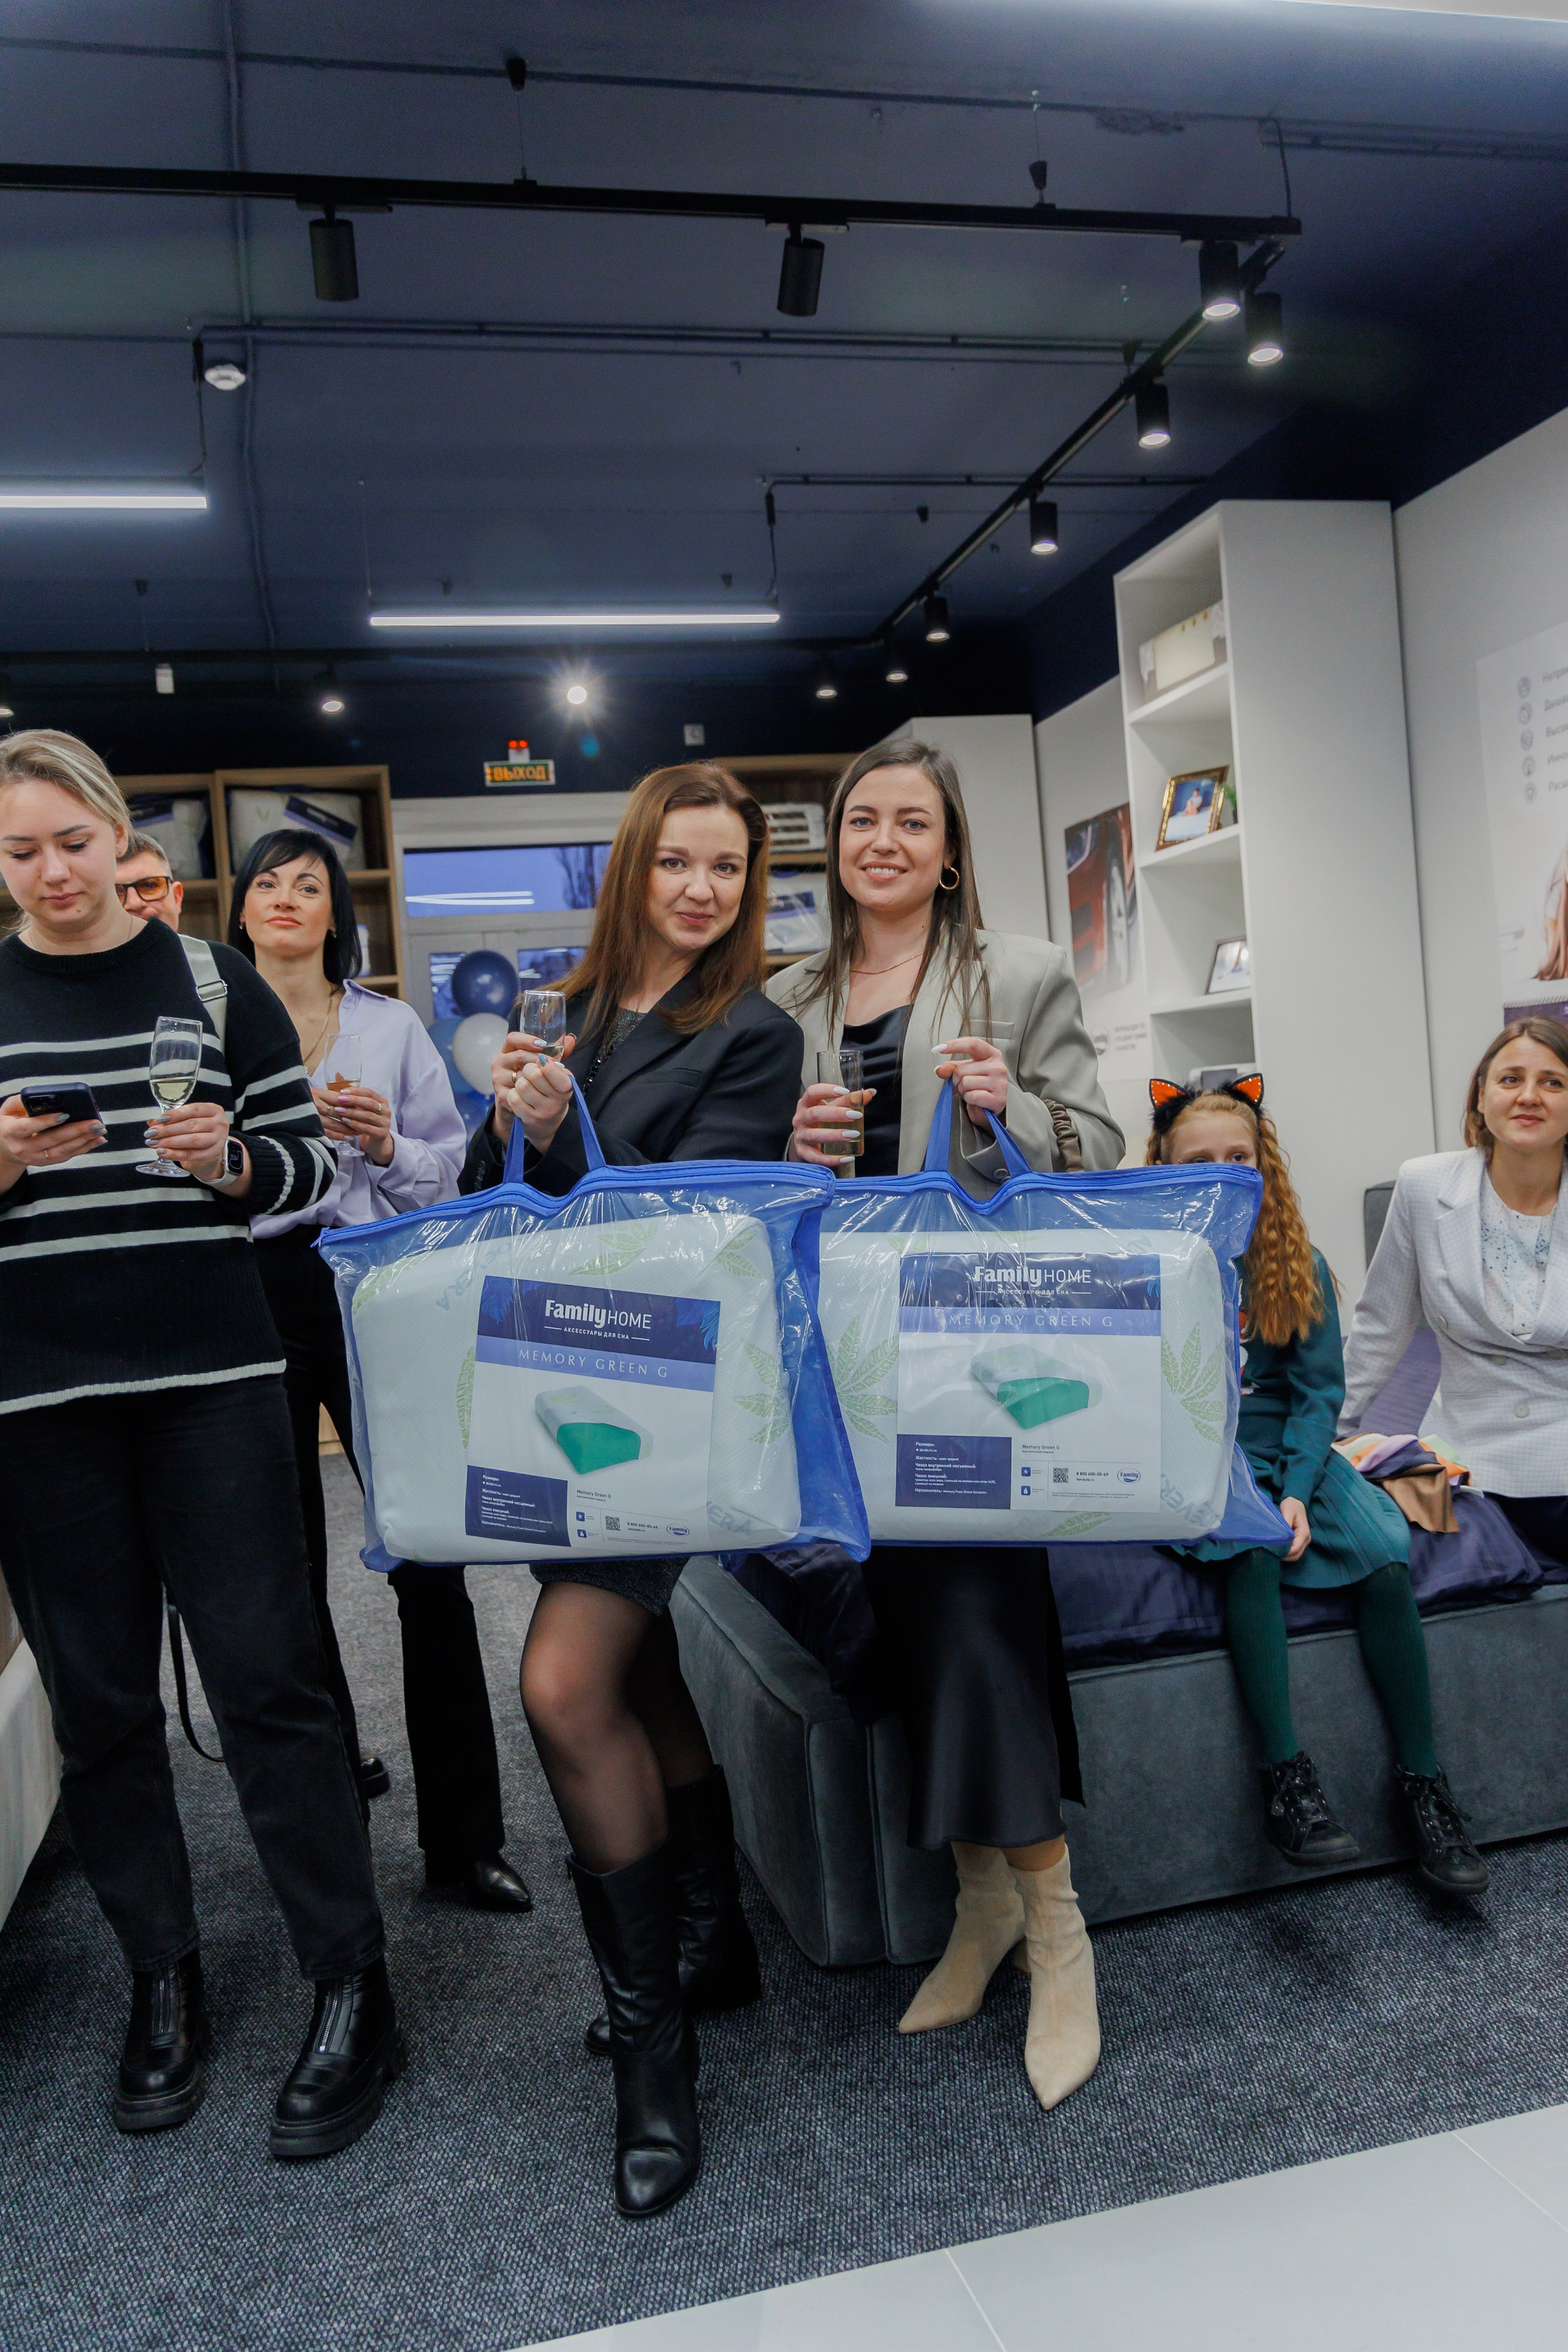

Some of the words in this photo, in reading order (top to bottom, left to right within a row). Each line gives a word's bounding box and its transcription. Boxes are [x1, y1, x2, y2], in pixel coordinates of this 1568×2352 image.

[493, 765, 546, 781] ВЫХОД
[949, 1314, 1024, 1325] MEMORY
[1035, 1316, 1091, 1326] GREEN
[1102, 1317, 1112, 1327] G
[564, 1327, 602, 1336] АКСЕССУАРЫ
[519, 1349, 586, 1366] MEMORY
[595, 1359, 647, 1375] GREEN
[658, 1367, 667, 1378] G
[707, 1501, 751, 1536] ERA
